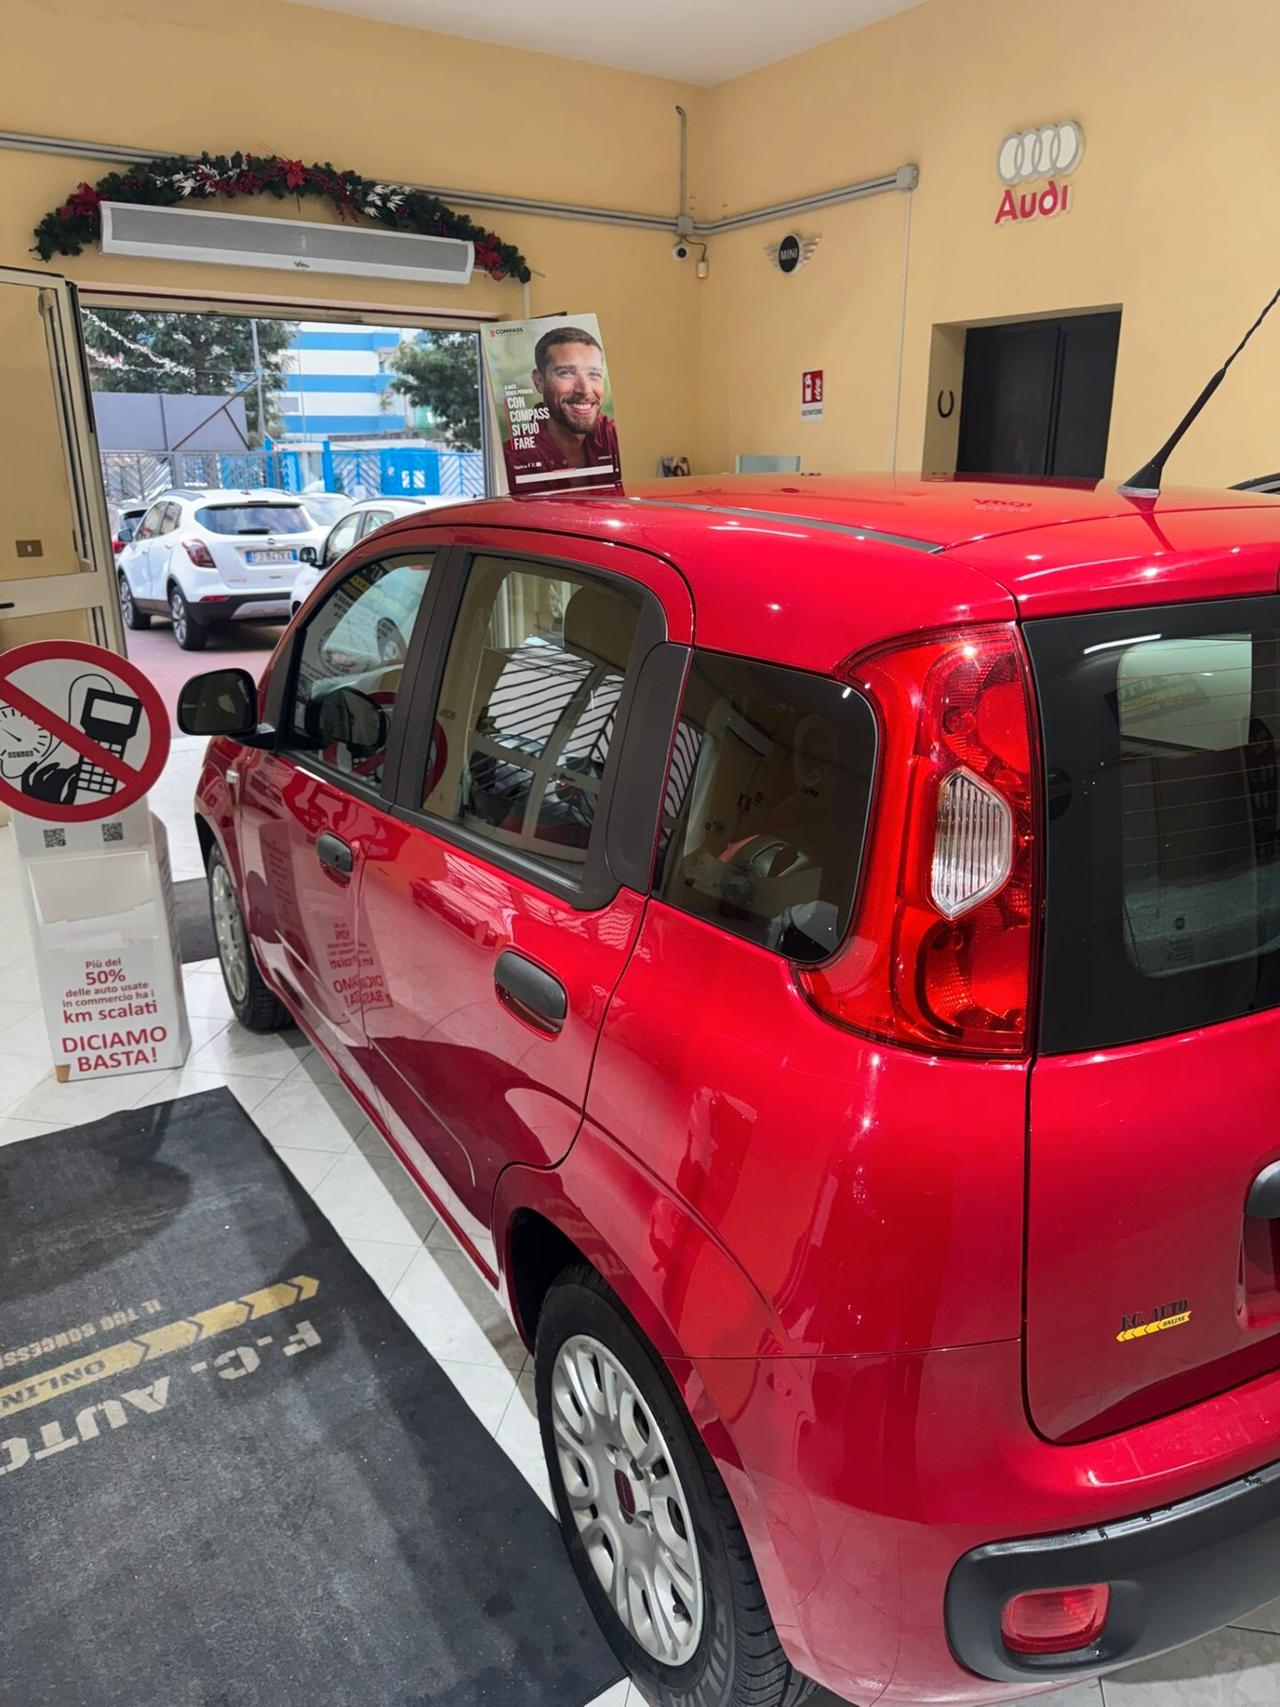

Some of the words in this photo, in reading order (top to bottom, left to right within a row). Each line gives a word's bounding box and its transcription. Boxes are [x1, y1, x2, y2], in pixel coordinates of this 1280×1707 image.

[994, 181, 1069, 224] Audi
[495, 327, 524, 335] COMPASS
[507, 396, 526, 410] CON
[509, 407, 550, 423] COMPASS
[512, 425, 521, 437] SI
[521, 418, 540, 436] PUÒ
[514, 436, 536, 450] FARE
[85, 960, 102, 969] Più
[105, 957, 121, 967] del
[85, 968, 126, 986] 50%
[65, 988, 91, 998] delle
[94, 985, 118, 995] auto
[121, 982, 149, 992] usate
[63, 1000, 73, 1008] in
[75, 993, 133, 1007] commercio
[136, 991, 149, 1000] ha
[63, 1010, 92, 1024] km
[98, 1000, 158, 1021] scalati
[62, 1026, 168, 1053] DICIAMO
[77, 1046, 158, 1073] BASTA!
[0, 1359, 106, 1409] ONLIN
